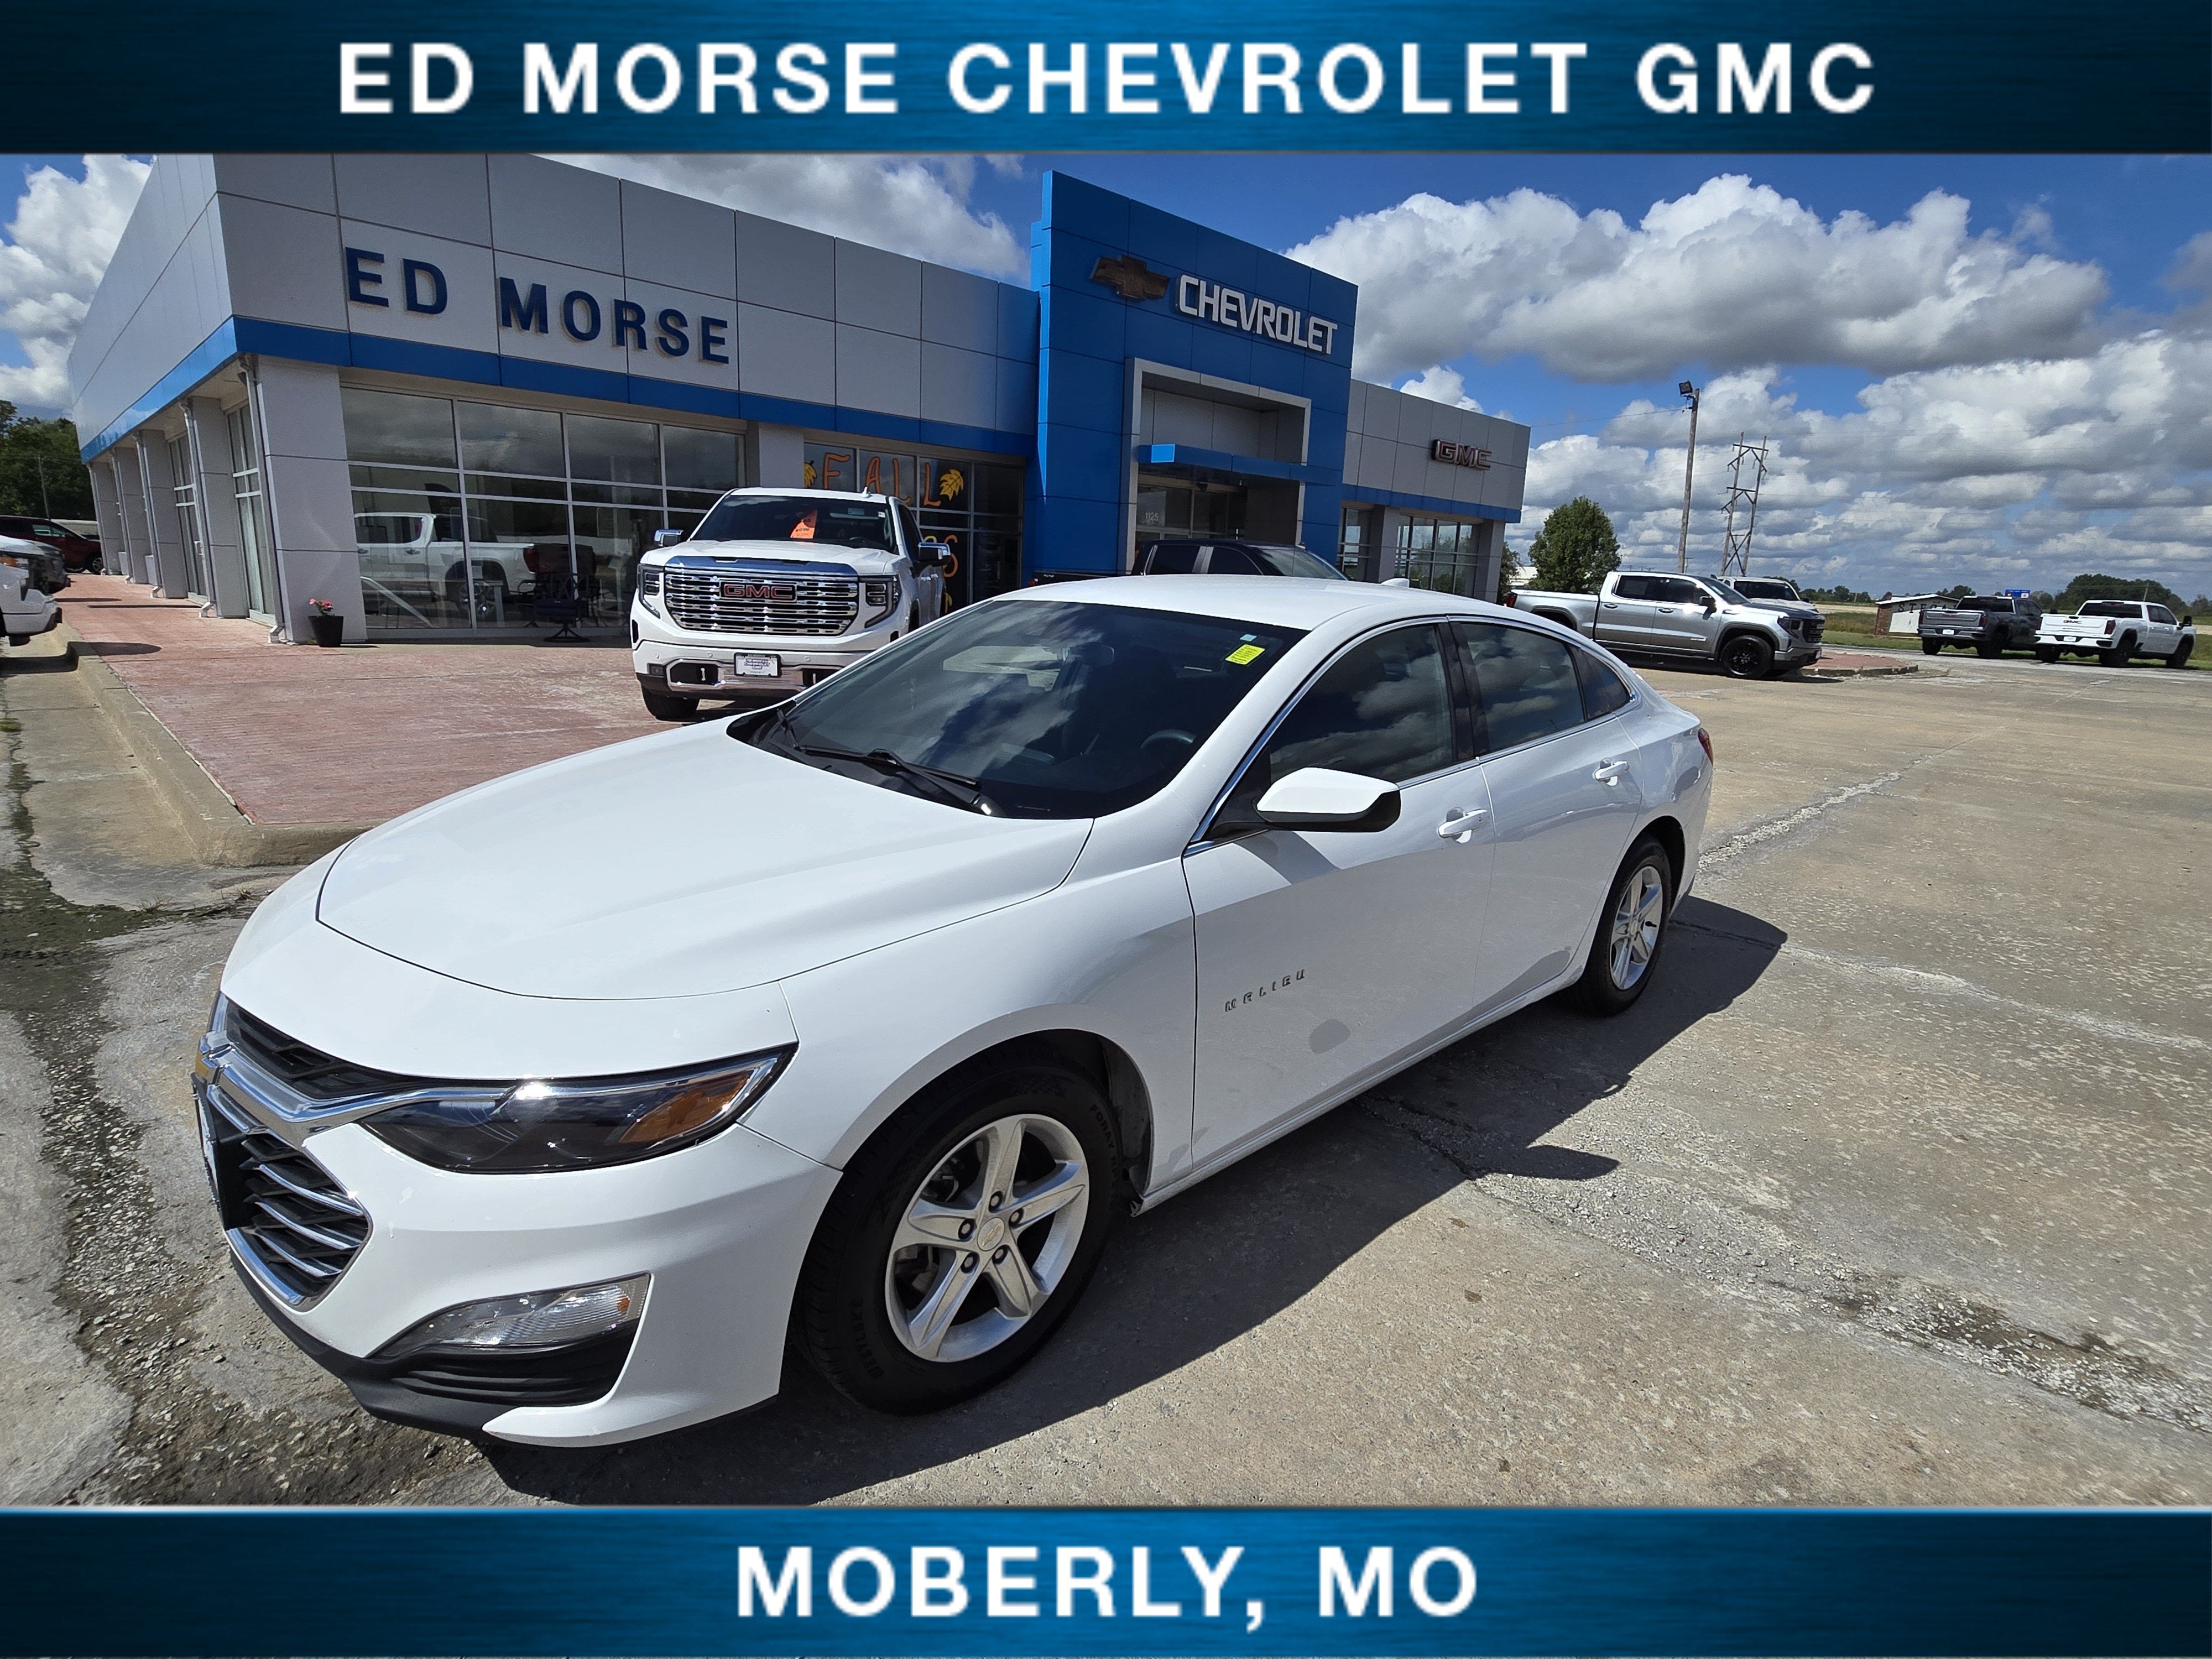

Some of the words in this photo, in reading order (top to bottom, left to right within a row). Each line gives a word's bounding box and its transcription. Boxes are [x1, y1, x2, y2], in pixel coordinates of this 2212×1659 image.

[345, 247, 448, 315] ED
[498, 276, 729, 364] MORSE
[1179, 274, 1338, 354] CHEVROLET
[1436, 439, 1492, 470] GMC
[823, 452, 941, 507] FALL
[1145, 512, 1159, 521] 1125
[724, 583, 793, 599] GMC
[1225, 969, 1305, 1012] MALIBU
